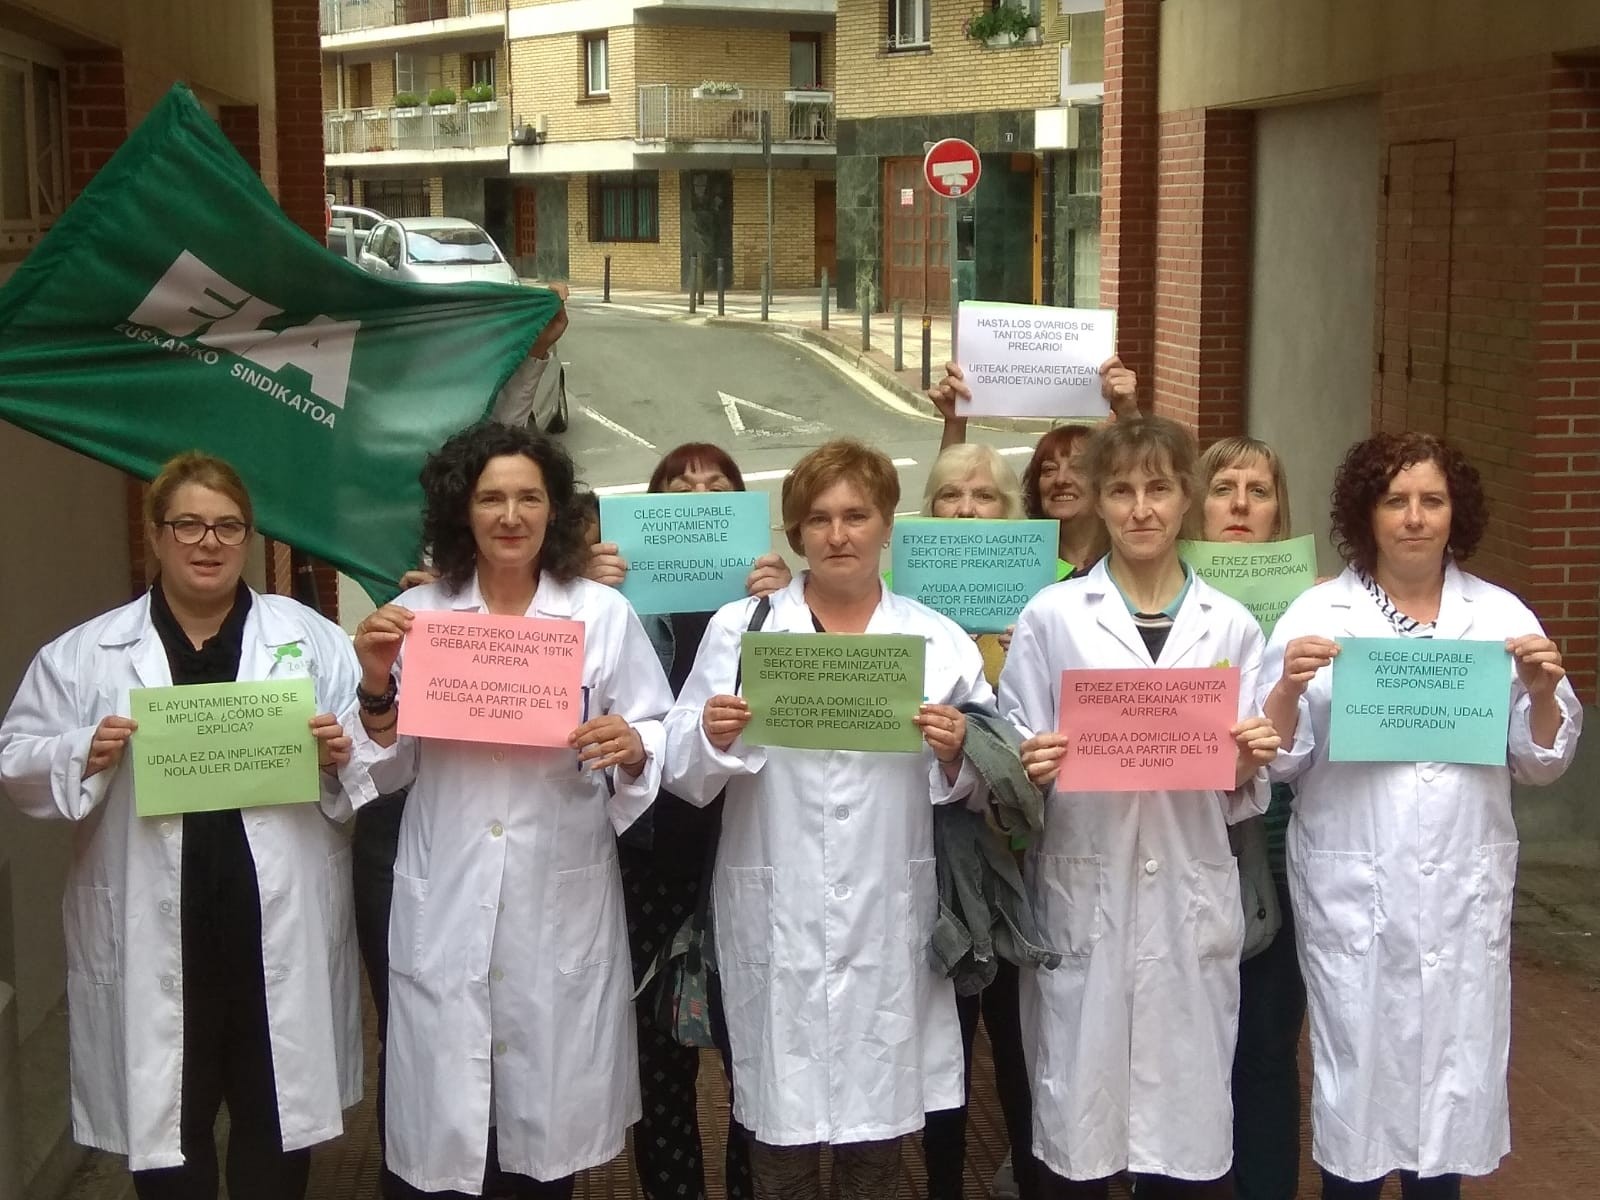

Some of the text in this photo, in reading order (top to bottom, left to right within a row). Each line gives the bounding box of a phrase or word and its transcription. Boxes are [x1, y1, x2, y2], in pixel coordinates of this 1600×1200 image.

[128, 249, 361, 409] ELA
[977, 319, 1095, 331] HASTA LOS OVARIOS DE
[993, 329, 1079, 341] TANTOS AÑOS EN
[1008, 342, 1062, 352] PRECARIO!
[969, 364, 1008, 374] URTEAK
[977, 375, 1092, 386] OBARIOETAINO GAUDE!
[230, 363, 336, 429] SINDIKATOA
[634, 506, 736, 519] CLECE CULPABLE,
[641, 519, 729, 532] AYUNTAMIENTO
[644, 532, 728, 545] RESPONSABLE
[902, 535, 937, 545] ETXEZ
[940, 535, 982, 545] ETXEKO
[911, 547, 962, 557] SEKTORE
[907, 558, 1041, 569] SEKTORE PREKARIZATUA
[1212, 553, 1292, 566] ETXEZ ETXEKO
[1196, 563, 1308, 578] AGUNTZA BORROKAN
[652, 571, 723, 583] ARDURADUN
[921, 584, 957, 593] AYUDA
[958, 584, 966, 593] A
[427, 623, 578, 644] ETXEZ ETXEKO LAGUNTZA
[430, 638, 573, 657] GREBARA EKAINAK 19TIK
[754, 647, 792, 656] ETXEZ
[795, 648, 843, 657] ETXEKO
[472, 654, 529, 667] AURRERA
[1368, 651, 1409, 662] CLECE
[763, 658, 819, 669] SEKTORE
[759, 671, 907, 682] SEKTORE PREKARIZATUA
[1374, 665, 1468, 677] AYUNTAMIENTO
[428, 677, 568, 697] AYUDA A DOMICILIO A LA
[1075, 681, 1226, 692] ETXEZ ETXEKO LAGUNTZA
[1376, 678, 1465, 690] RESPONSABLE
[149, 692, 298, 712] EL AYUNTAMIENTO NO SE
[426, 690, 568, 711] HUELGA A PARTIR DEL 19
[775, 696, 813, 705] AYUDA
[815, 697, 824, 705] A
[1078, 693, 1222, 704] GREBARA EKAINAK 19TIK
[220, 707, 264, 722] ¿CÓMO
[267, 706, 283, 716] SE
[469, 707, 523, 720] DE JUNIO
[769, 707, 819, 717] SECTOR
[1120, 707, 1178, 717] AURRERA
[1345, 704, 1494, 718] CLECE ERRUDUN, UDALA
[197, 721, 254, 735] EXPLICA?
[765, 718, 900, 730] SECTOR PRECARIZADO
[1379, 718, 1456, 730] ARDURADUN
[1079, 732, 1217, 742] AYUDA A DOMICILIO A LA
[147, 744, 302, 766] UDALA EZ DA INPLIKATZEN
[1077, 744, 1218, 755] HUELGA A PARTIR DEL 19
[164, 758, 291, 777] NOLA ULER DAITEKE?
[1120, 757, 1174, 768] DE JUNIO
